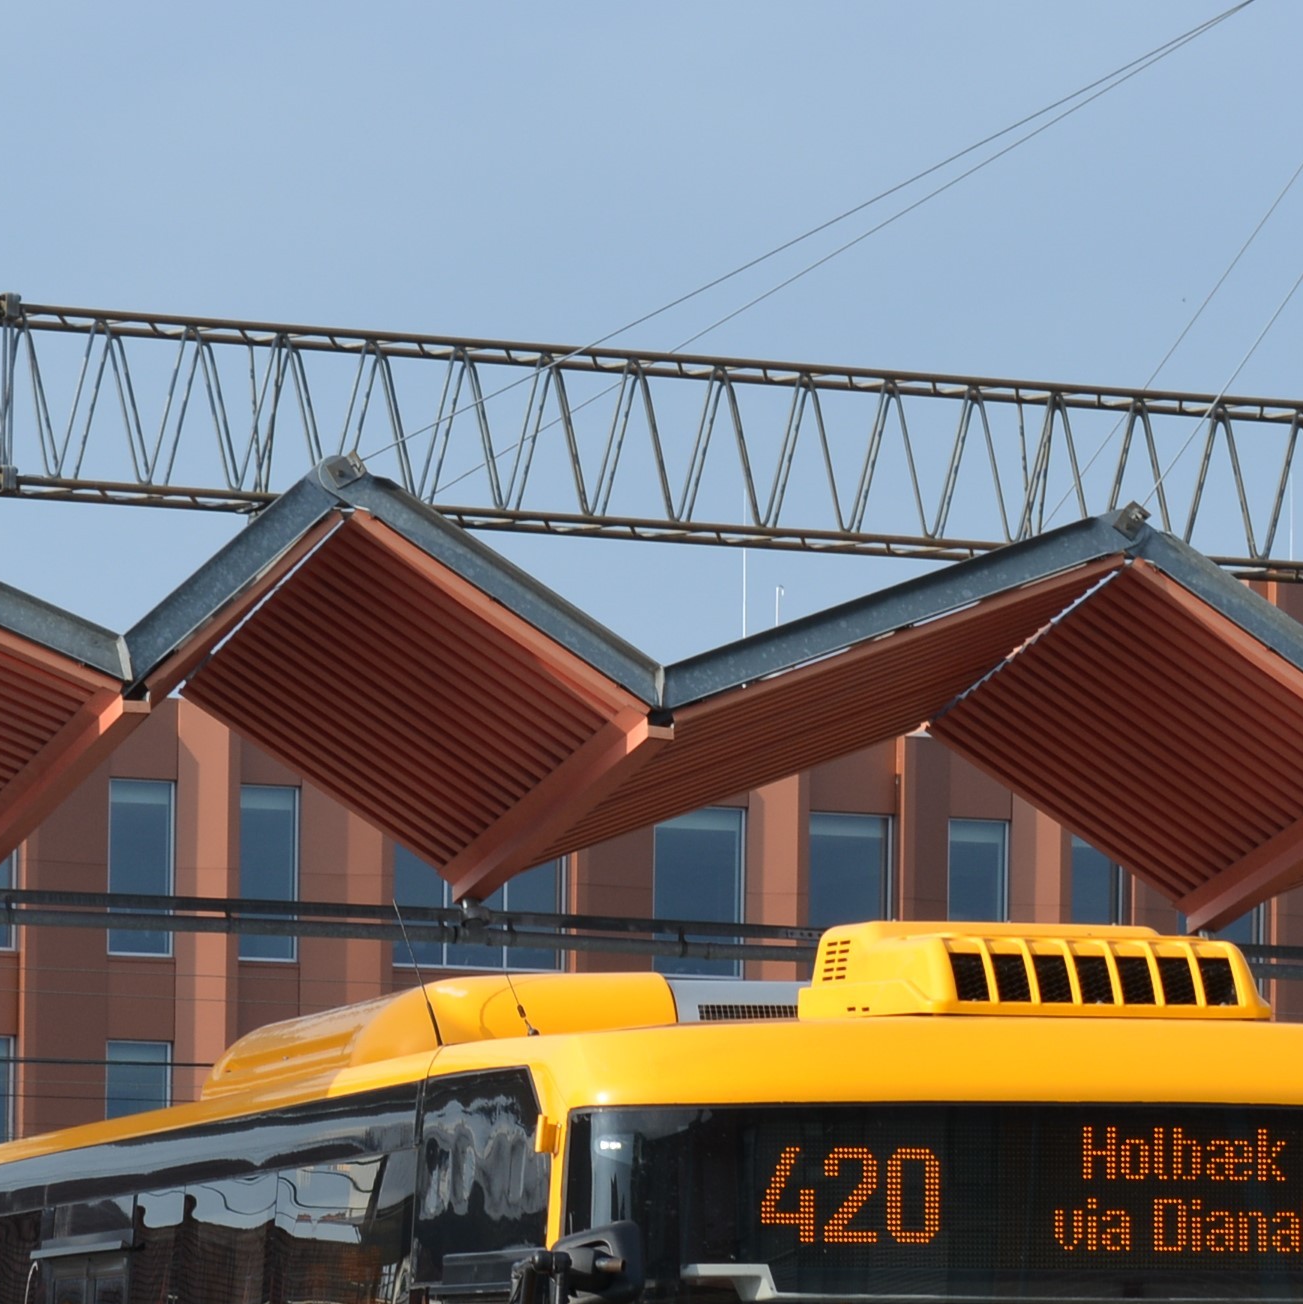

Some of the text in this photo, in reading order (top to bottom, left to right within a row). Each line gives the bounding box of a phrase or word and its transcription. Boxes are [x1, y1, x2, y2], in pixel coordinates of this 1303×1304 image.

[1082, 1126, 1287, 1182] Holbæk
[760, 1147, 940, 1243] 420
[1054, 1198, 1131, 1252] via
